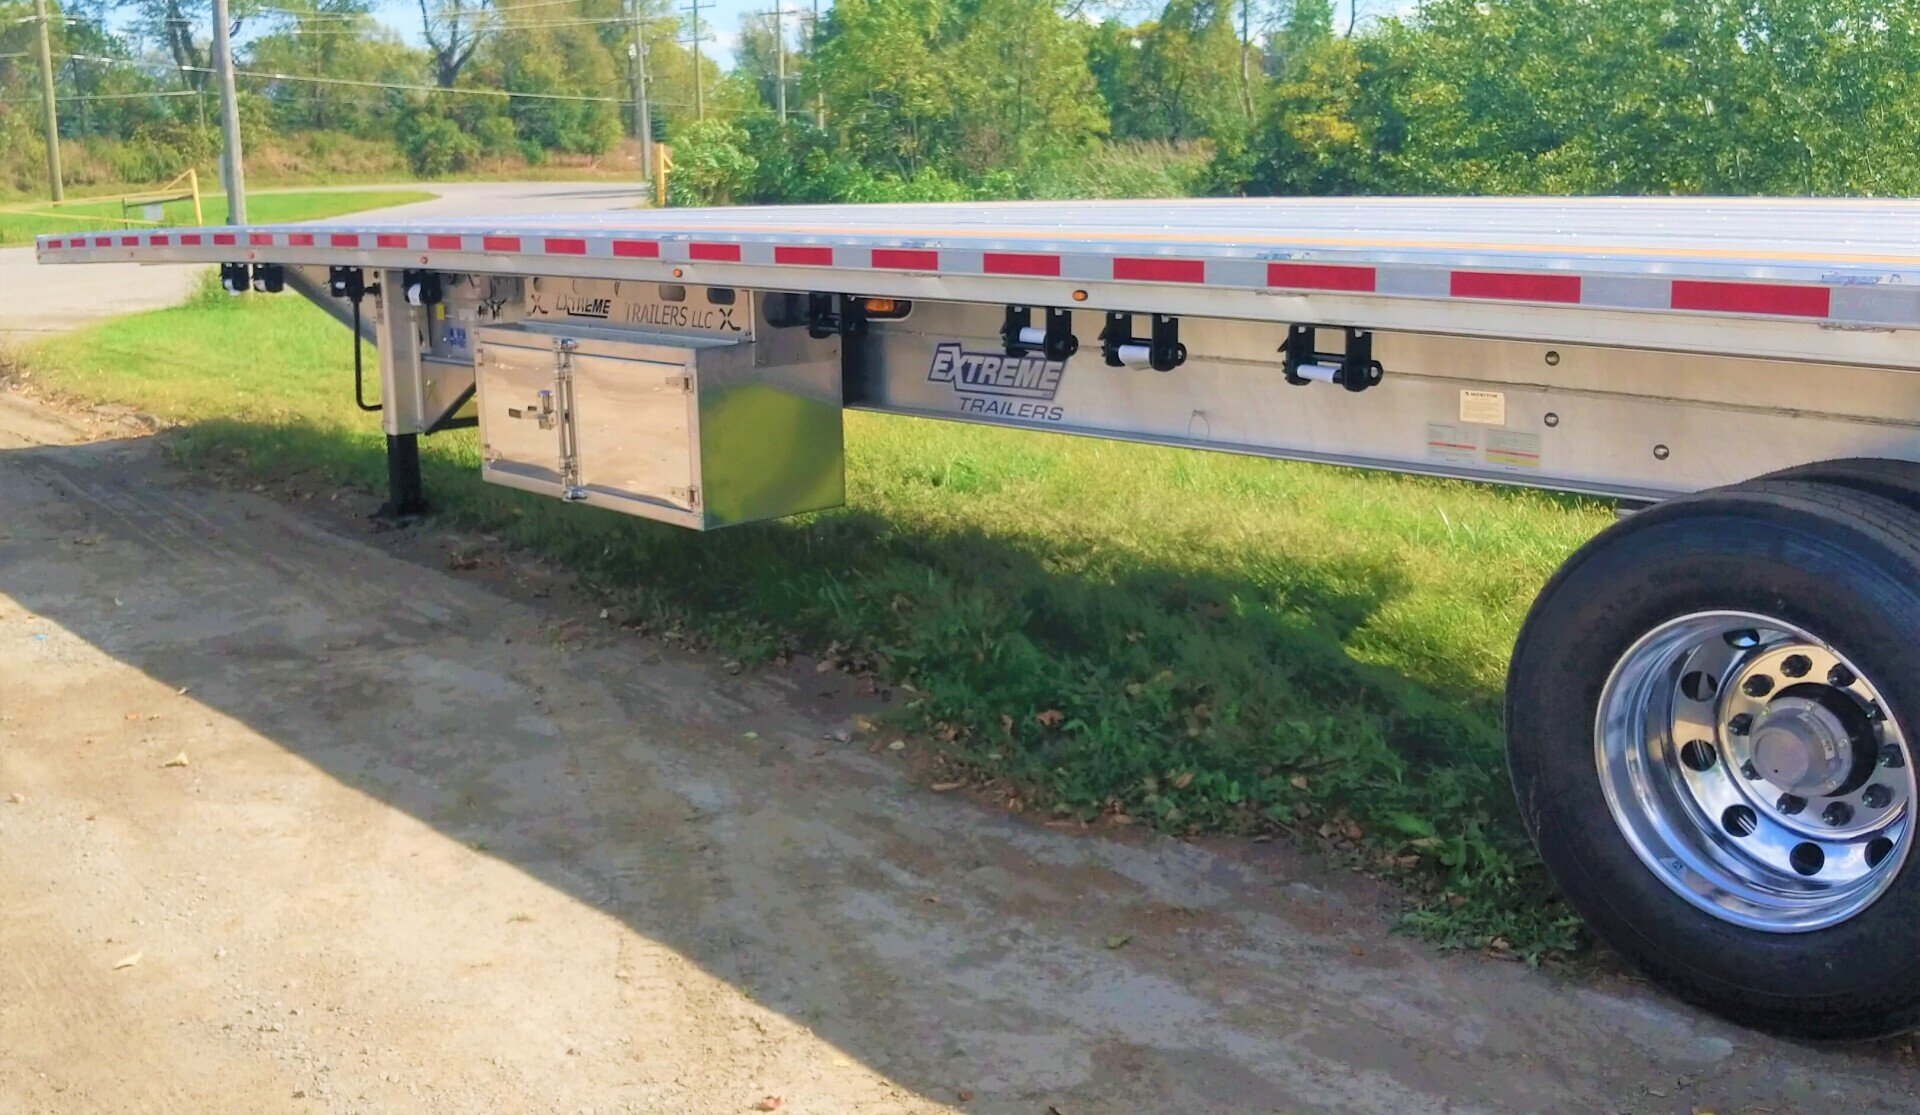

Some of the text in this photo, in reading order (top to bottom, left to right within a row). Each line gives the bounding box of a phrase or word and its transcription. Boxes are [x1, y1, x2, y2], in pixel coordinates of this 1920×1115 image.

[624, 302, 688, 327] TRAILERS
[692, 309, 714, 329] LLC
[928, 343, 1066, 400] EXTREME
[960, 397, 1064, 421] TRAILERS
